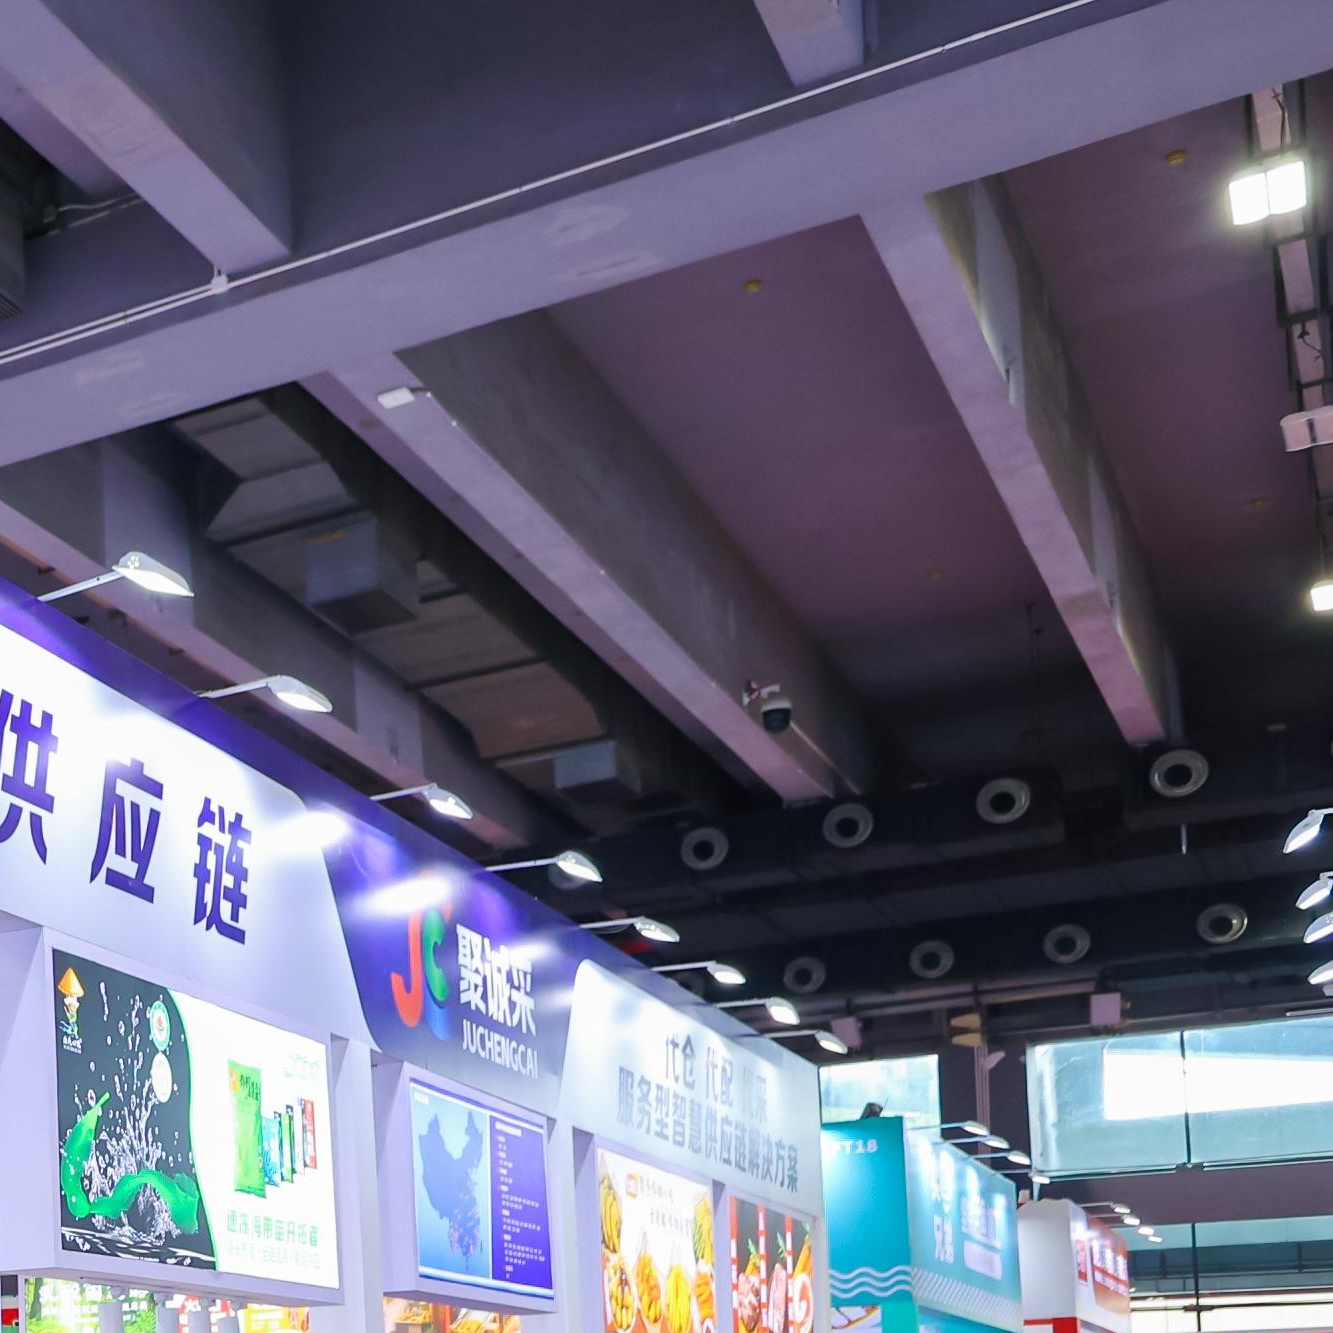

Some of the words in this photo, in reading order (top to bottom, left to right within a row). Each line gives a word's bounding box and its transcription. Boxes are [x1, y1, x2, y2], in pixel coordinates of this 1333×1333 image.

[463, 1019, 539, 1080] JUCHENGCAI
[618, 1065, 798, 1193] 服务型智慧供应链解决方案
